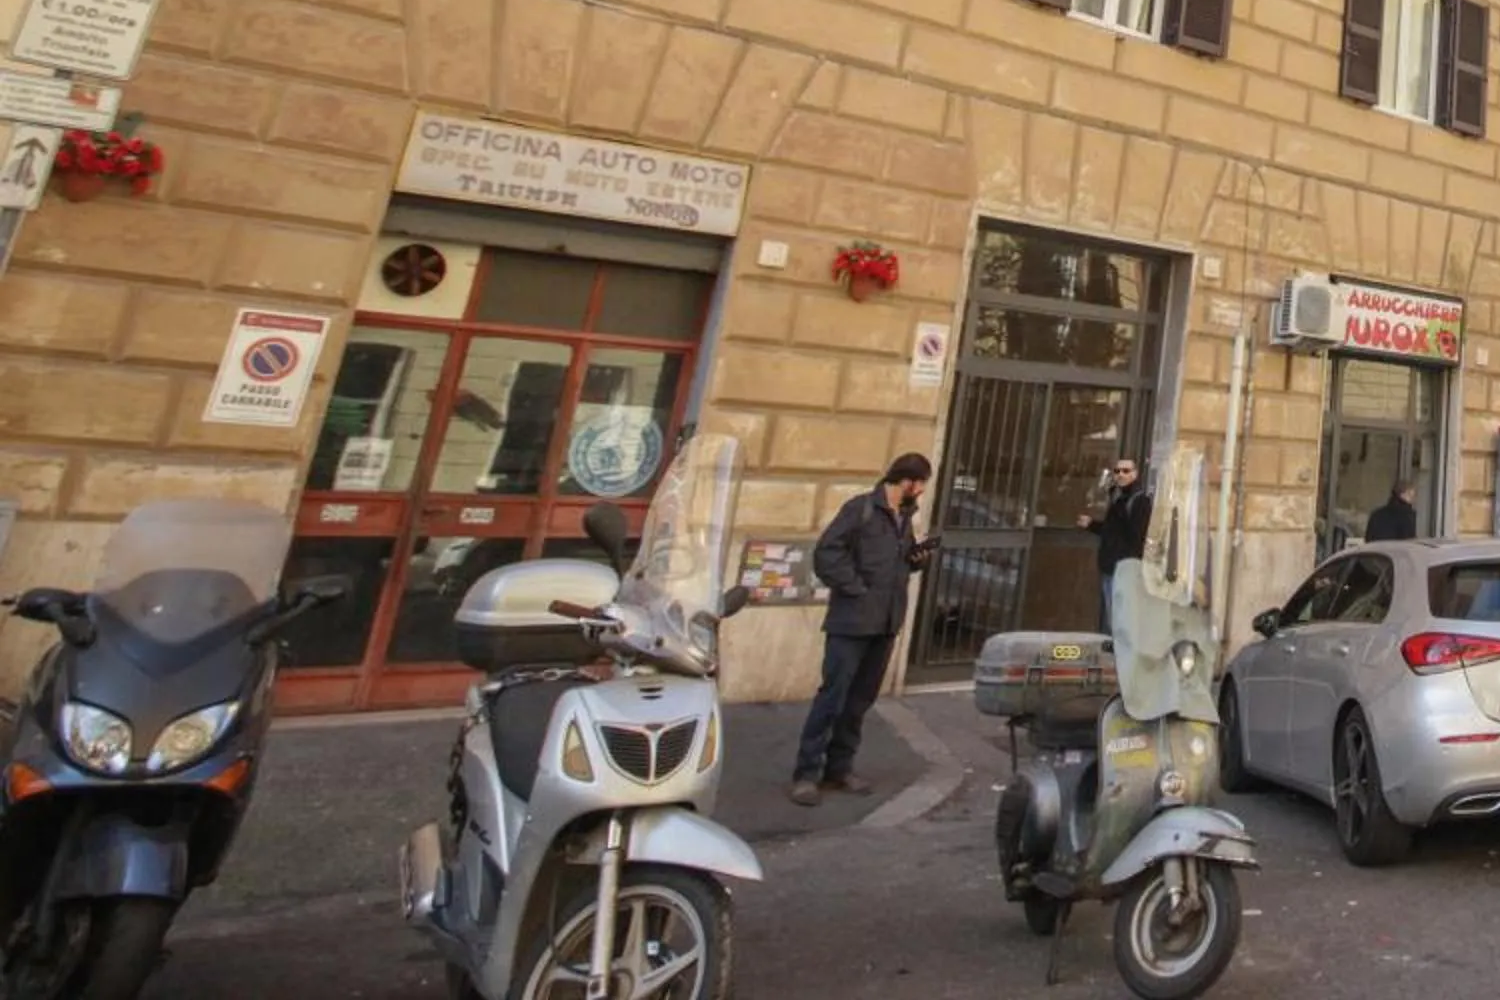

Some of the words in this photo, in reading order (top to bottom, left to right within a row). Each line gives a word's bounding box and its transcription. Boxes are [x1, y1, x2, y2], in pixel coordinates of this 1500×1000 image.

[421, 121, 561, 161] OFFICINA
[578, 148, 657, 175] AUTO
[670, 161, 742, 188] MOTO
